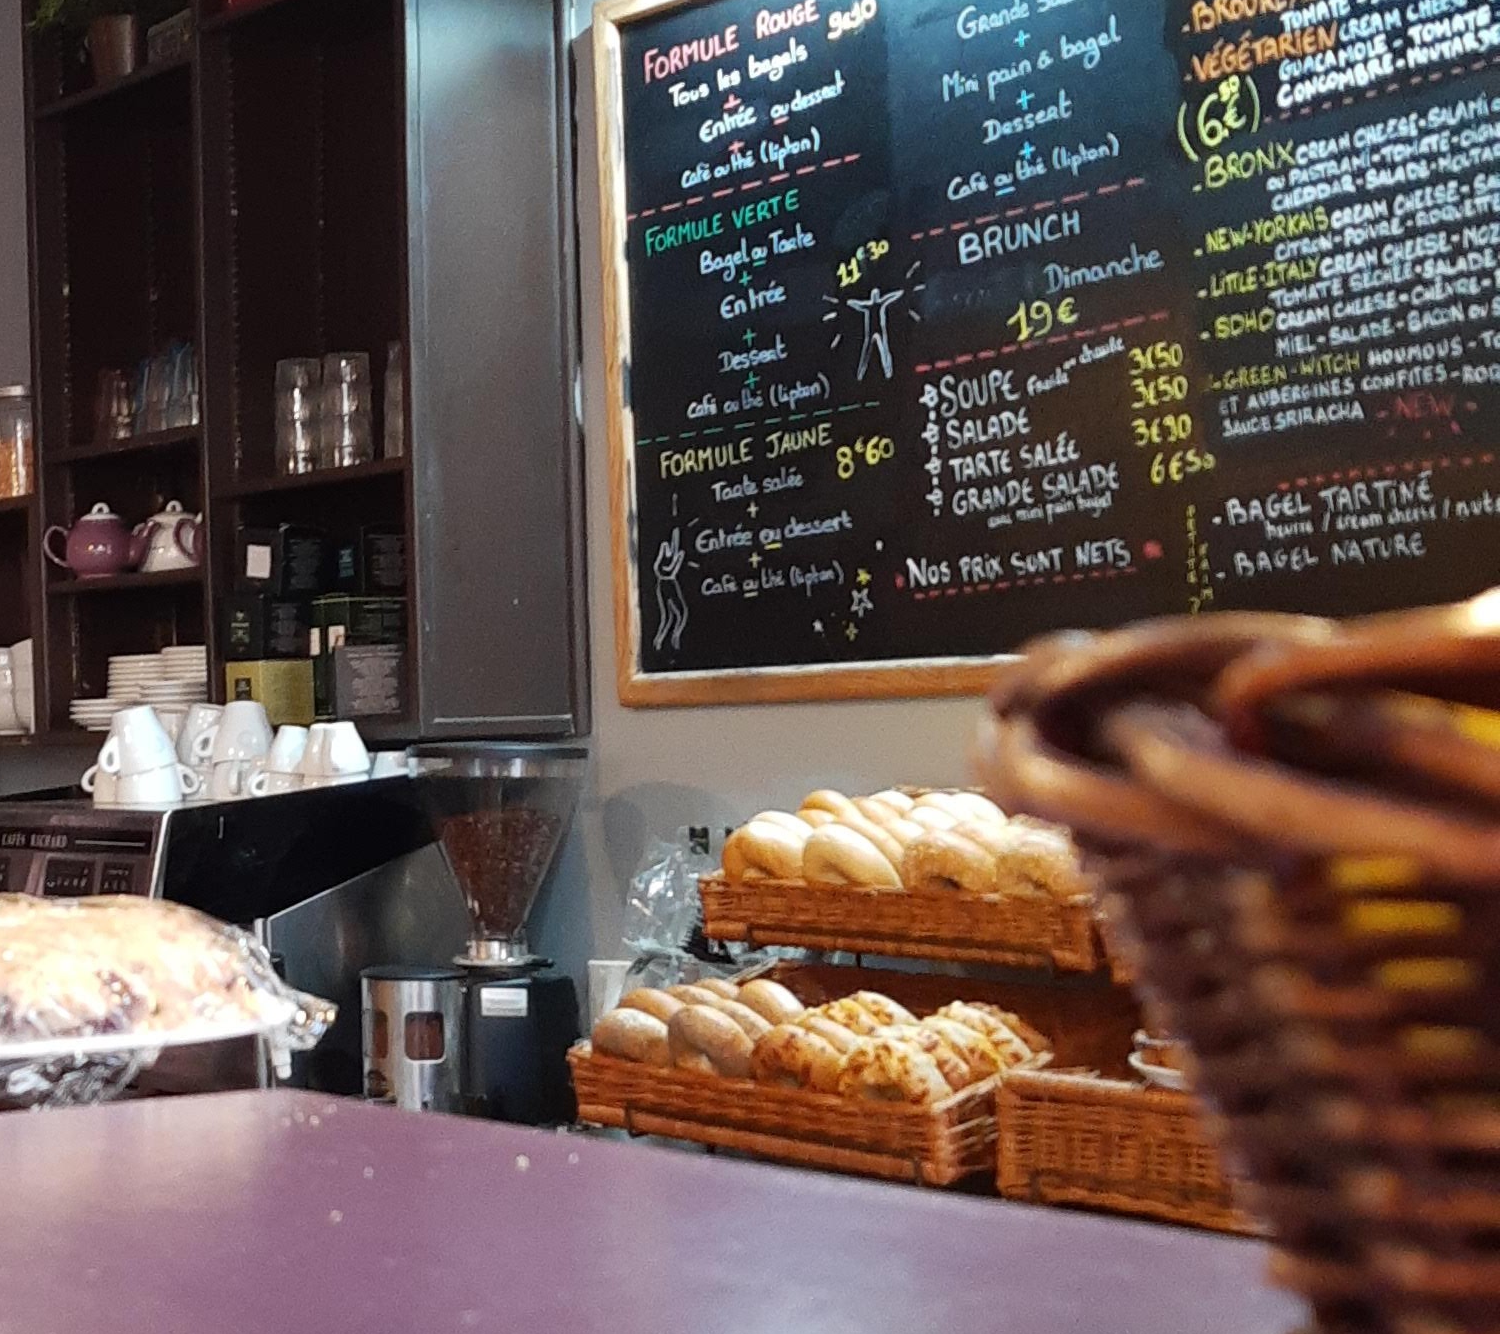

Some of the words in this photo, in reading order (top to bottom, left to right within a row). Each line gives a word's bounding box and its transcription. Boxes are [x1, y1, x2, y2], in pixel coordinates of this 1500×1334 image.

[644, 25, 739, 84] FORMULE
[942, 70, 979, 102] Mini
[988, 58, 1031, 101] pain
[1060, 15, 1121, 69] bagel
[1192, 20, 1337, 82] VÉGÉTARIEN
[1339, 8, 1402, 42] CREAM
[1279, 33, 1389, 81] GUACAMOLE
[1407, 4, 1491, 45] TOMATE
[669, 82, 710, 107] Tous
[749, 37, 808, 81] bagels
[1277, 53, 1394, 107] CONCOMBRE
[700, 107, 758, 143] Entrée
[1205, 139, 1295, 188] BRONX
[645, 213, 724, 257] FORMULE
[731, 189, 800, 229] VERTE
[958, 209, 1081, 265] BRUNCH
[700, 238, 748, 281] Bagel
[769, 223, 816, 255] Tarte
[1044, 243, 1165, 294] Dimanche
[720, 281, 786, 319] Entrée
[1268, 277, 1344, 308] TOMATE
[1006, 297, 1079, 342] 19€
[1214, 307, 1275, 339] SOHO
[719, 335, 788, 373] Dessert
[1367, 336, 1462, 367] HOUMOUS
[940, 369, 1021, 417] SOUPE
[1247, 378, 1355, 411] AUBERGINES
[1361, 364, 1447, 392] CONFITES
[946, 407, 1032, 450] SALADE
[1222, 418, 1271, 438] SAUCE
[1275, 401, 1365, 431] SRIRACHA
[660, 438, 753, 479] FORMULE
[766, 423, 832, 459] JAUNE
[949, 448, 1013, 484] TARTE
[1019, 431, 1081, 469] SALÉE
[711, 475, 758, 503] Tarte
[762, 467, 804, 493] salée
[952, 476, 1034, 516] GRANDE
[1041, 461, 1120, 499] SALADE
[696, 523, 752, 553] Entrée
[784, 509, 852, 539] dessert
[1226, 492, 1311, 526] BAGEL
[959, 554, 1004, 582] PRIX
[1010, 547, 1063, 577] SONT
[1075, 538, 1131, 567] NETS
[1234, 546, 1319, 577] BAGEL
[1331, 532, 1426, 565] NATURE
